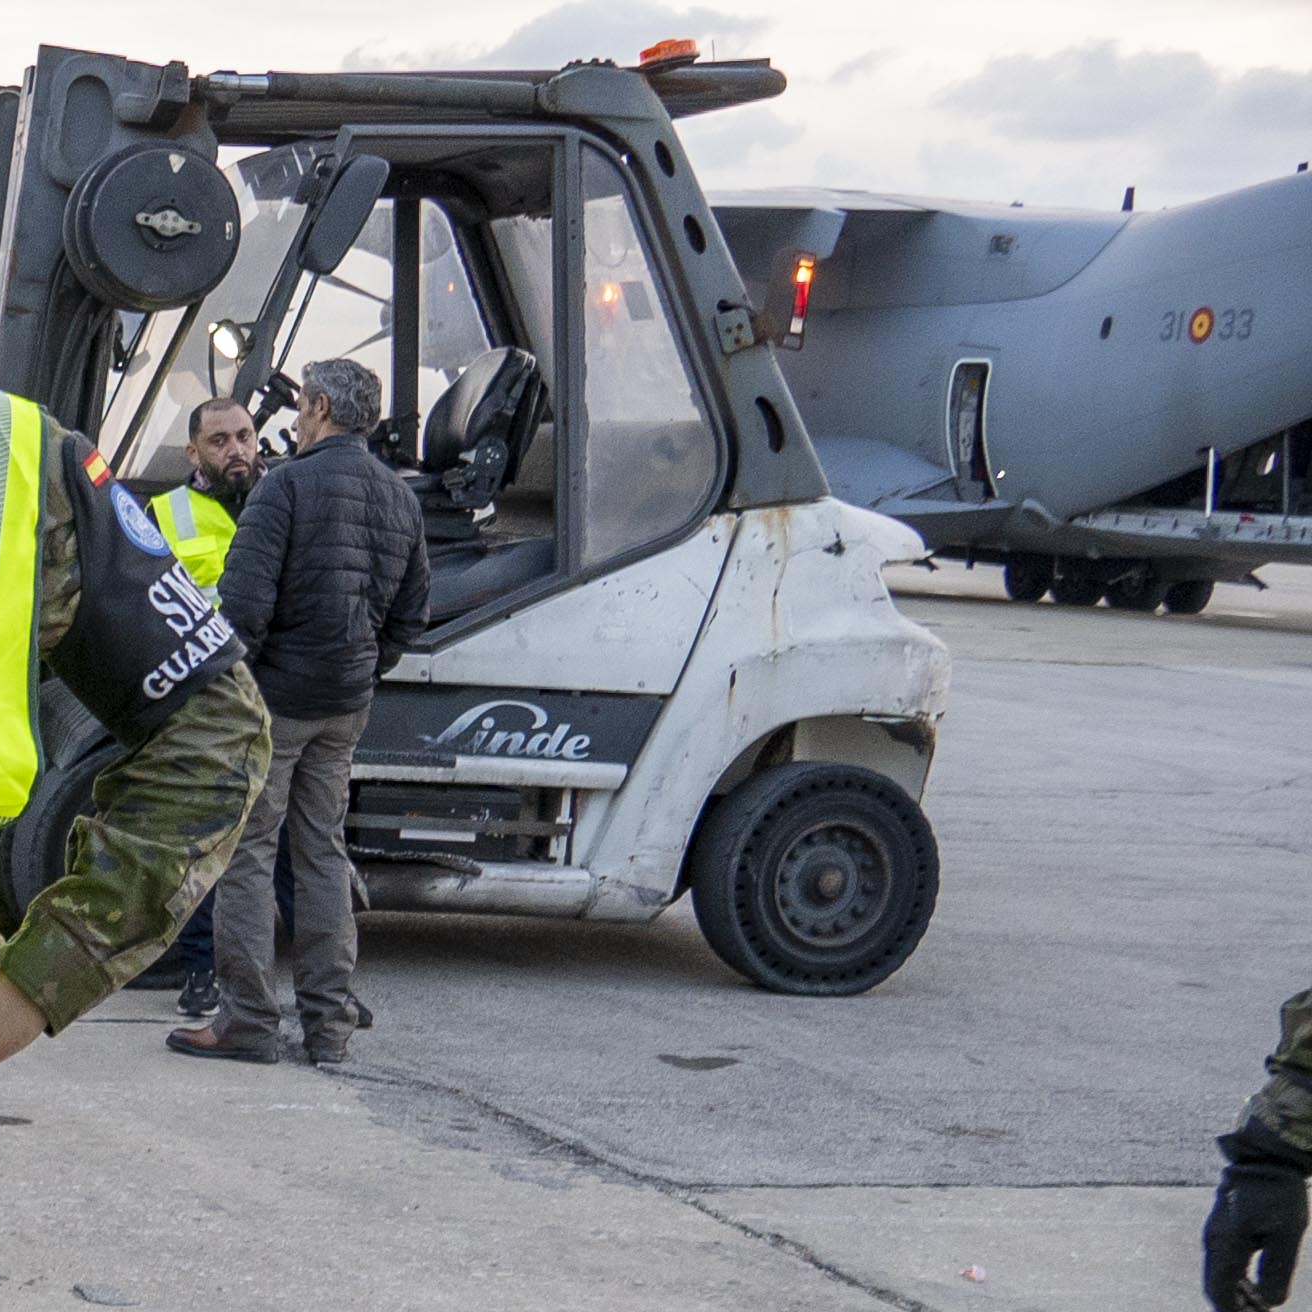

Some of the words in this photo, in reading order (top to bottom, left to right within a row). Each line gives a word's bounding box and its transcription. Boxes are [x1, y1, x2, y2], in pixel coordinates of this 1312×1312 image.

[1159, 310, 1185, 342] 31
[1217, 308, 1255, 342] 33
[417, 699, 592, 760] Linde
